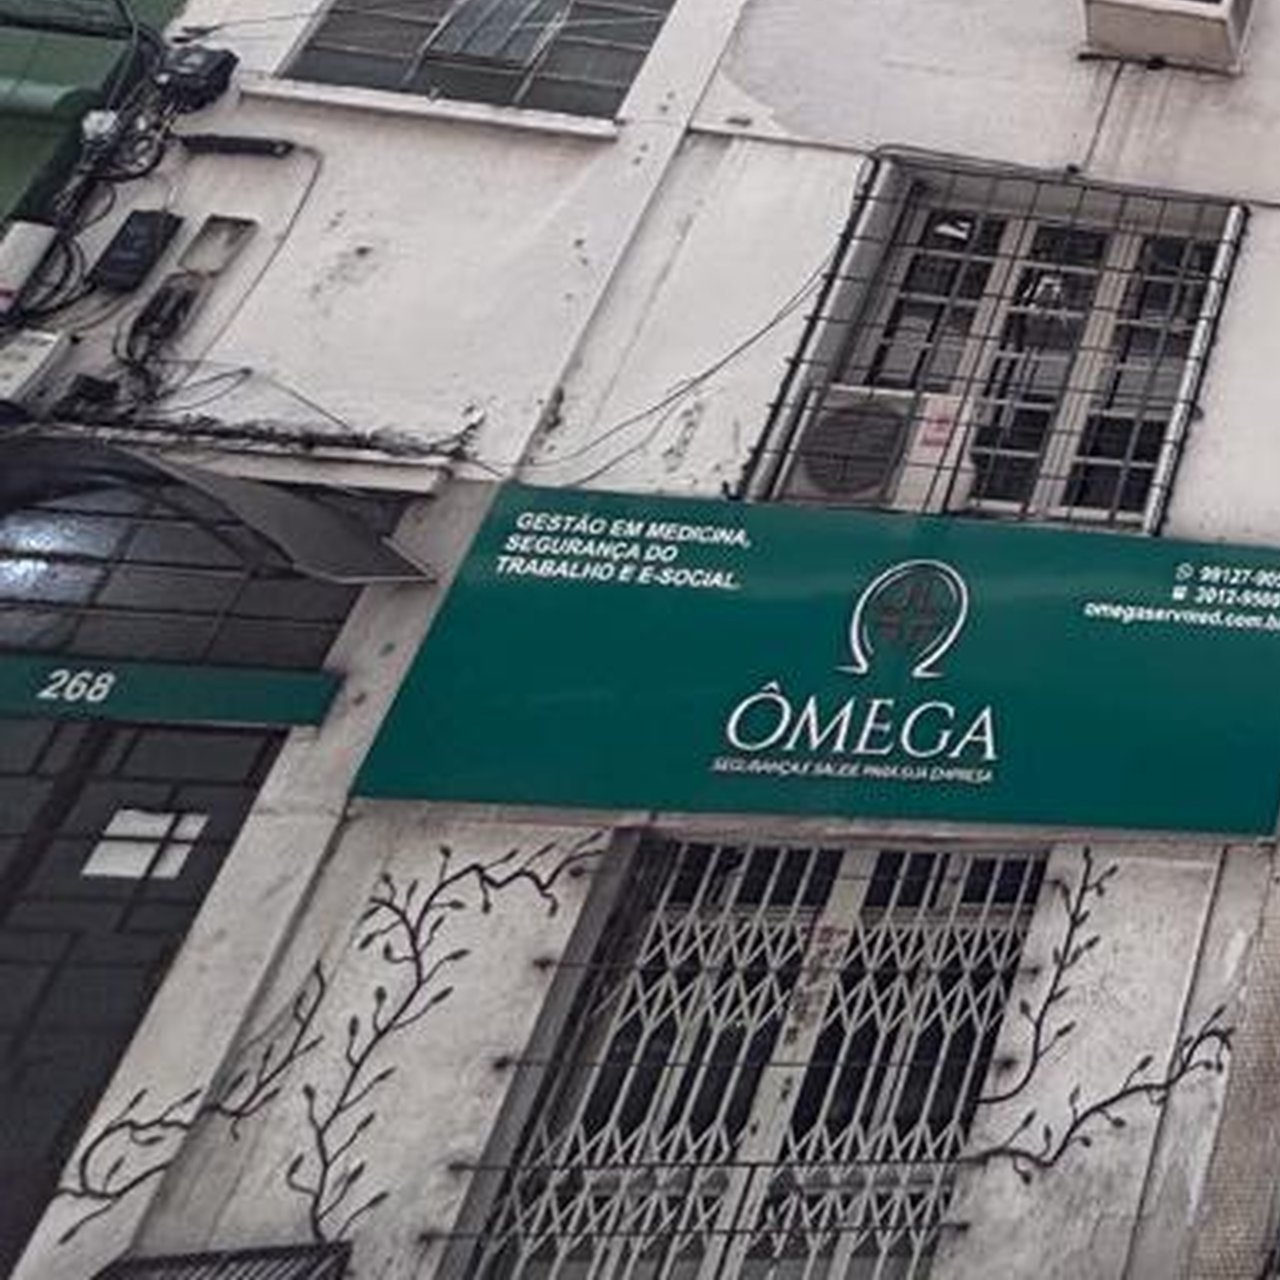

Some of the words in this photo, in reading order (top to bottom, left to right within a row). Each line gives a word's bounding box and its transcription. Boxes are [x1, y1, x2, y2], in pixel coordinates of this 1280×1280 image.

[516, 511, 608, 535] GESTÃO
[609, 519, 642, 538] EM
[645, 521, 752, 548] MEDICINA,
[505, 534, 640, 562] SEGURANÇA
[644, 544, 678, 563] DO
[496, 556, 615, 581] TRABALHO
[618, 564, 636, 582] E
[36, 669, 116, 702] 268
[725, 680, 998, 761] ÔMEGA
